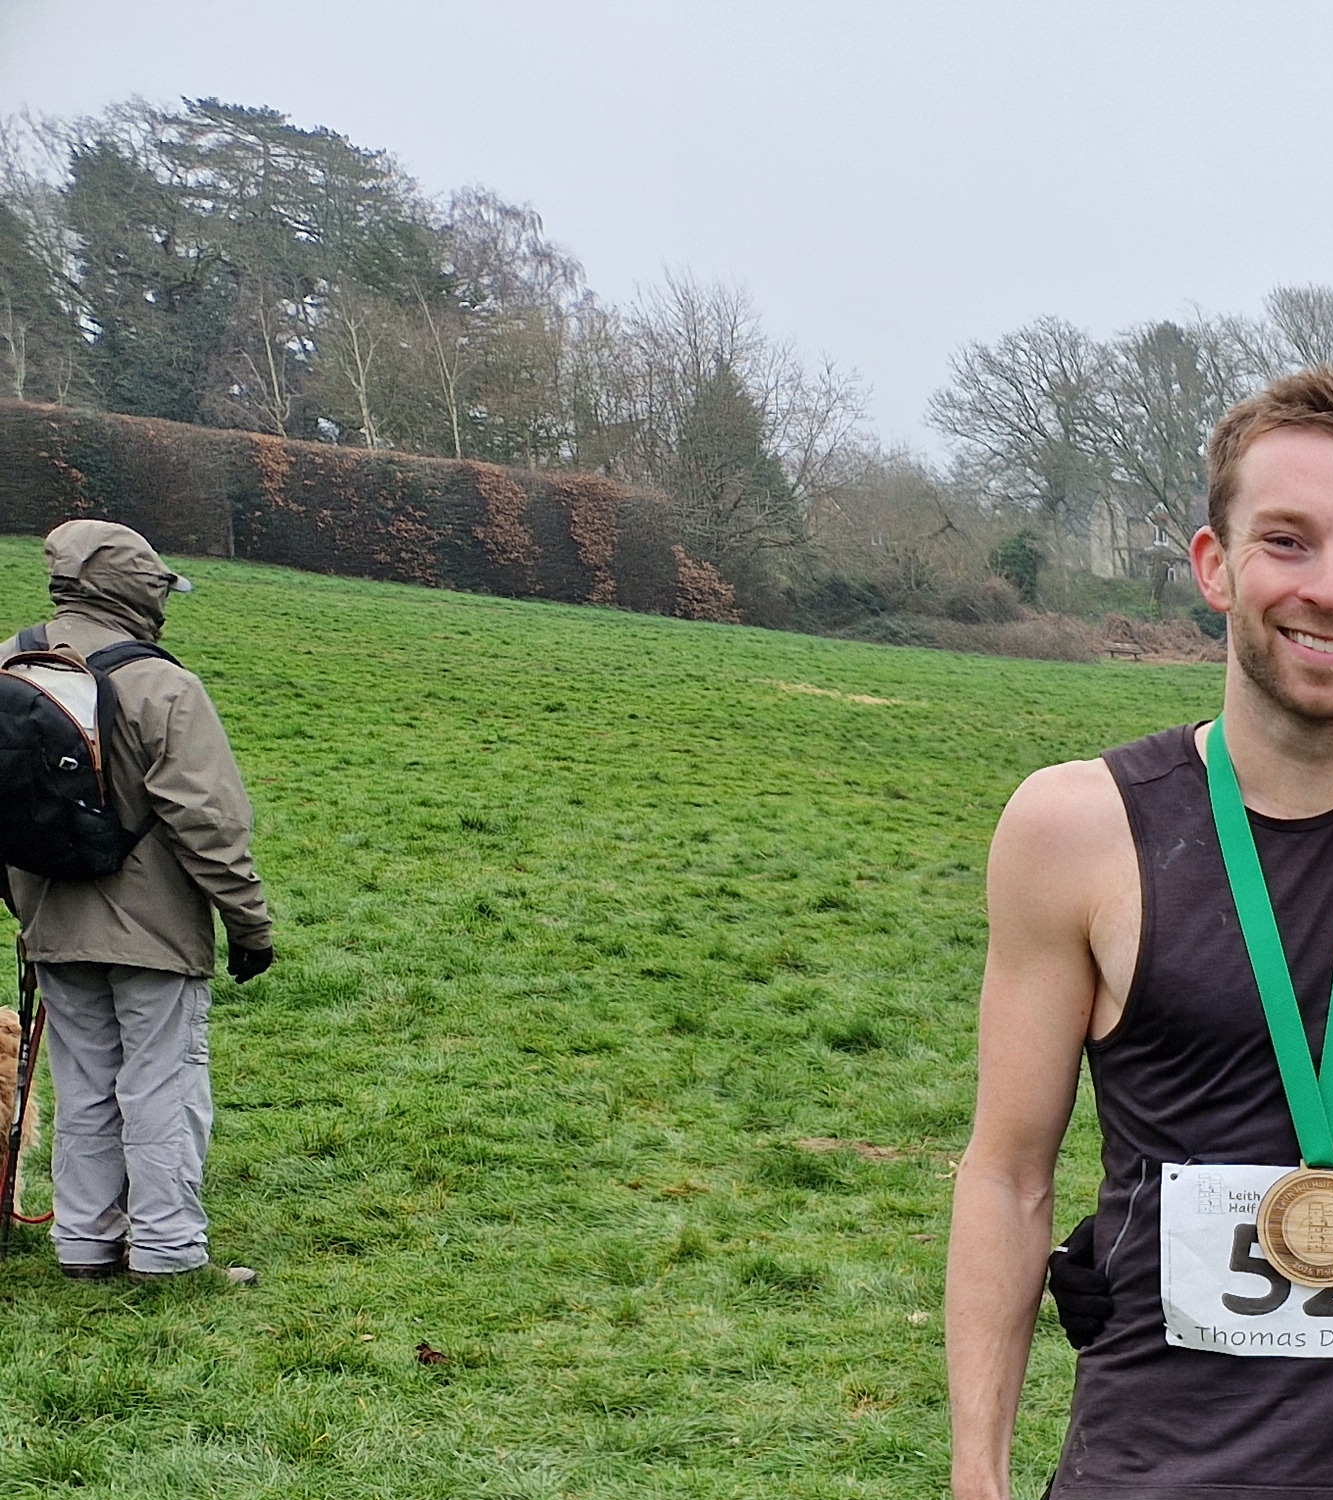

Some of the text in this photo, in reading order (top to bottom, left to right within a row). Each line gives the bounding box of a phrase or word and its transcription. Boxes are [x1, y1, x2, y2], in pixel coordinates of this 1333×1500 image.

[1228, 1190, 1261, 1202] Leith
[1228, 1202, 1258, 1215] Half
[1193, 1325, 1307, 1348] Thomas
